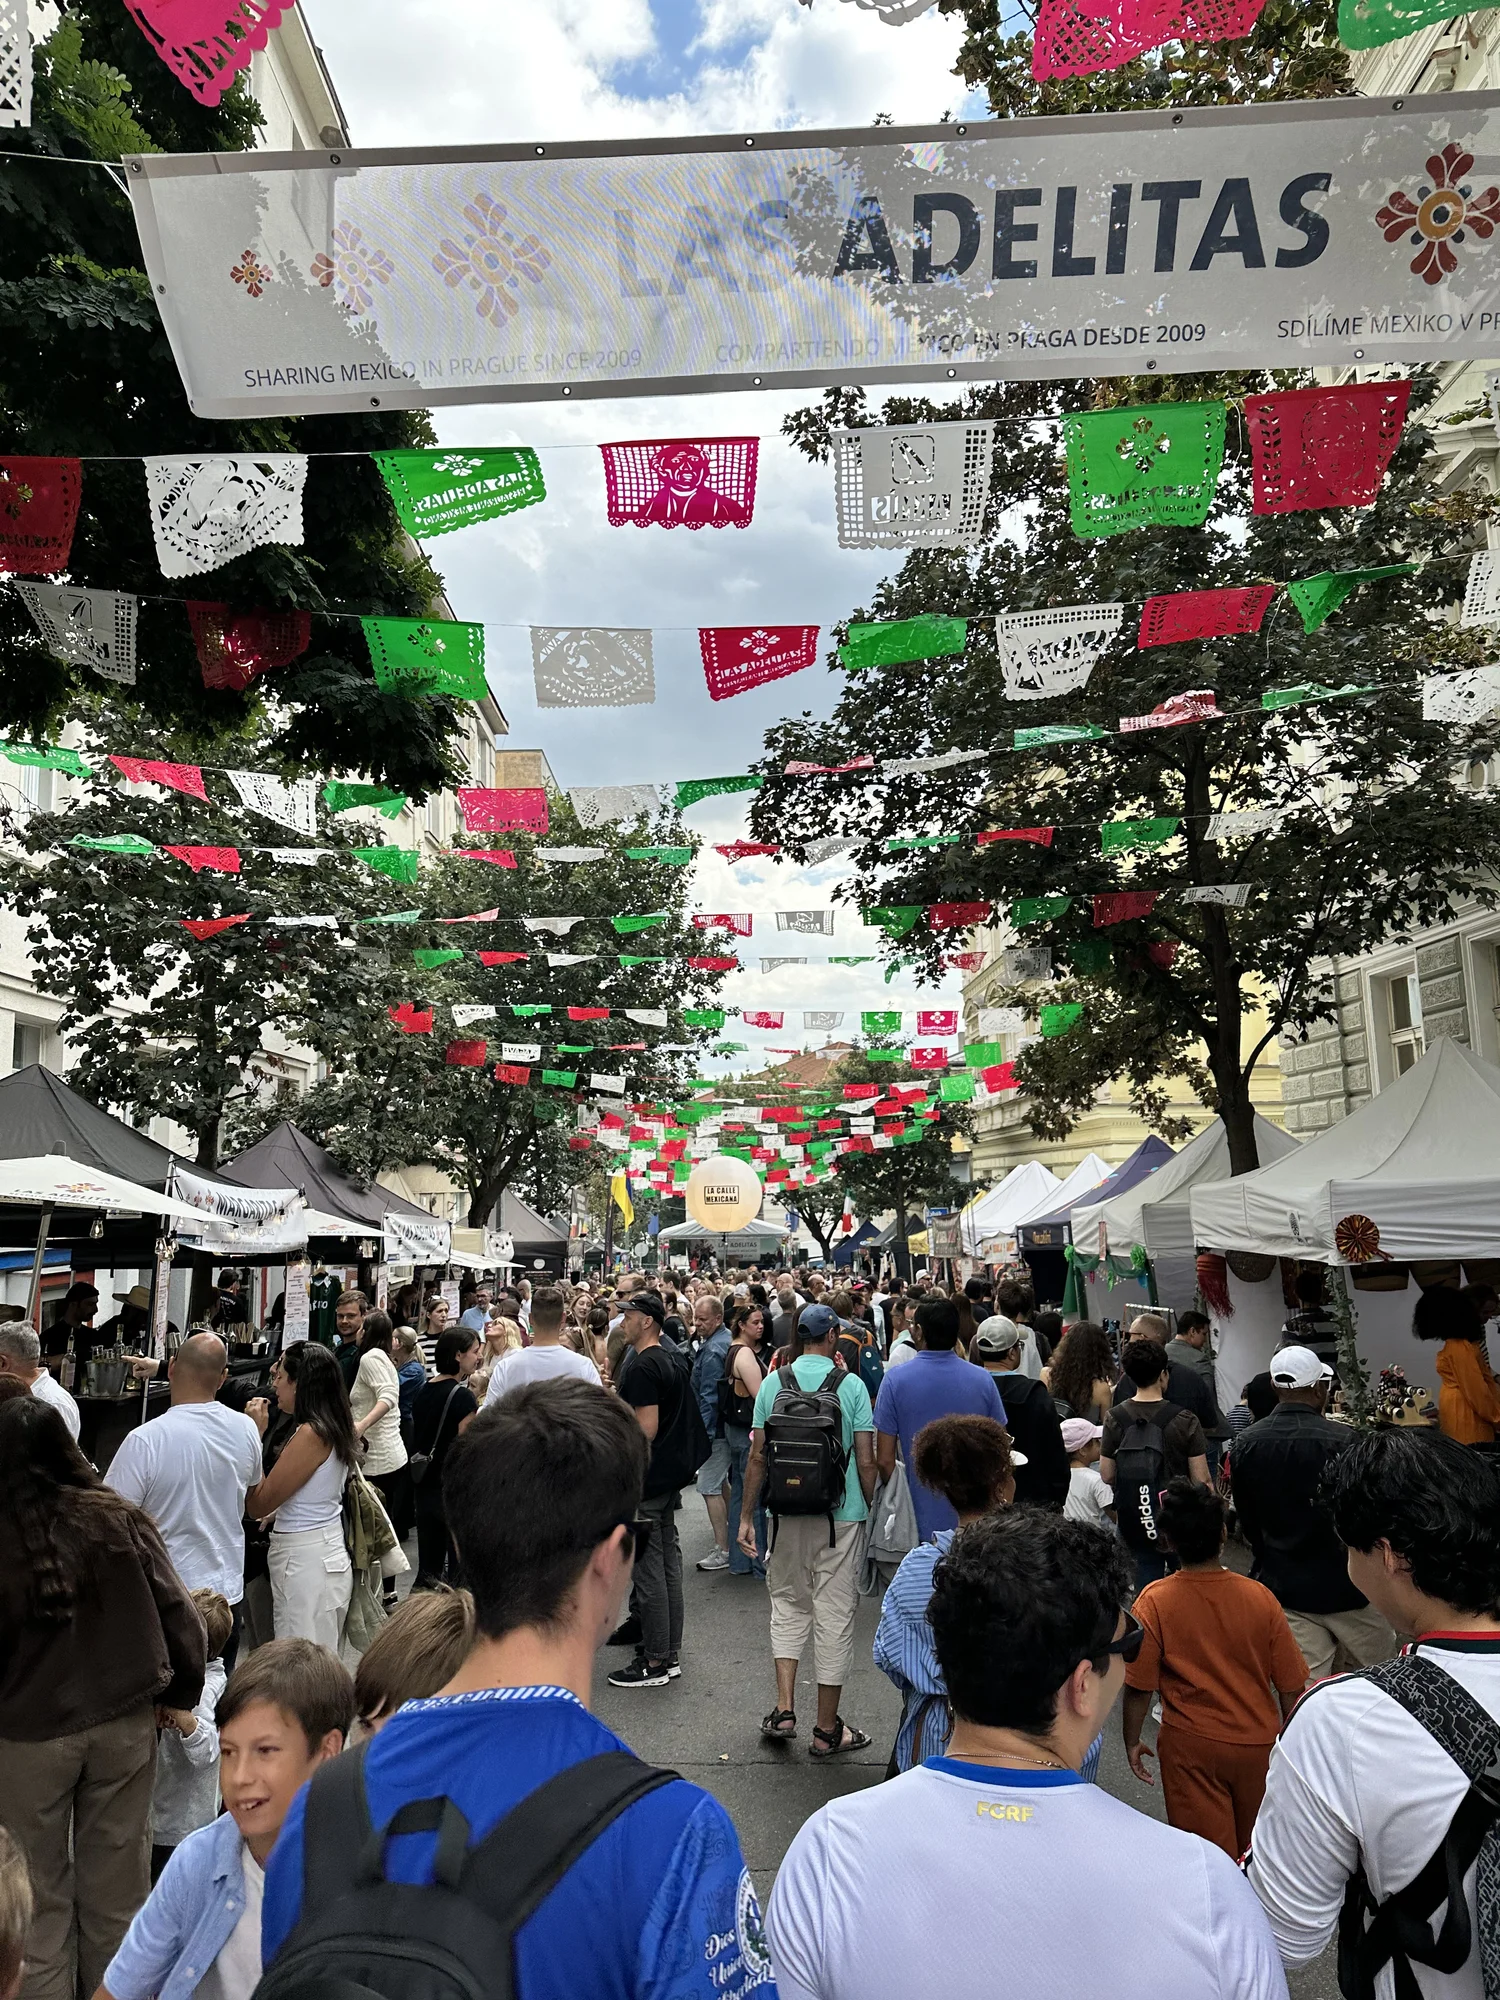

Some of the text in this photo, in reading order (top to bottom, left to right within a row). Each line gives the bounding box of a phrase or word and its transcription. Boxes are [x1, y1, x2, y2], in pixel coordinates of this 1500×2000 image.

[613, 171, 1333, 298] LAS ADELITAS
[1277, 313, 1364, 338] SDÍLÍME
[1369, 313, 1453, 334] MEXIKO
[1459, 312, 1474, 331] V
[715, 337, 880, 363] COMPARTIENDO
[1006, 328, 1078, 350] PRAGA
[1083, 326, 1151, 347] DESDE
[1156, 323, 1206, 344] 2009
[244, 349, 642, 388] SHARING MEXICO IN PRAGUE SINCE 2009
[541, 636, 563, 656] VIVA
[720, 649, 802, 680] LAS ADELITAS
[47, 1192, 122, 1203] ADELITAS
[705, 1195, 738, 1203] MEXICANA
[707, 1186, 736, 1195] LA CALLE
[1138, 1484, 1158, 1541] adidas
[976, 1800, 1034, 1823] FCRF
